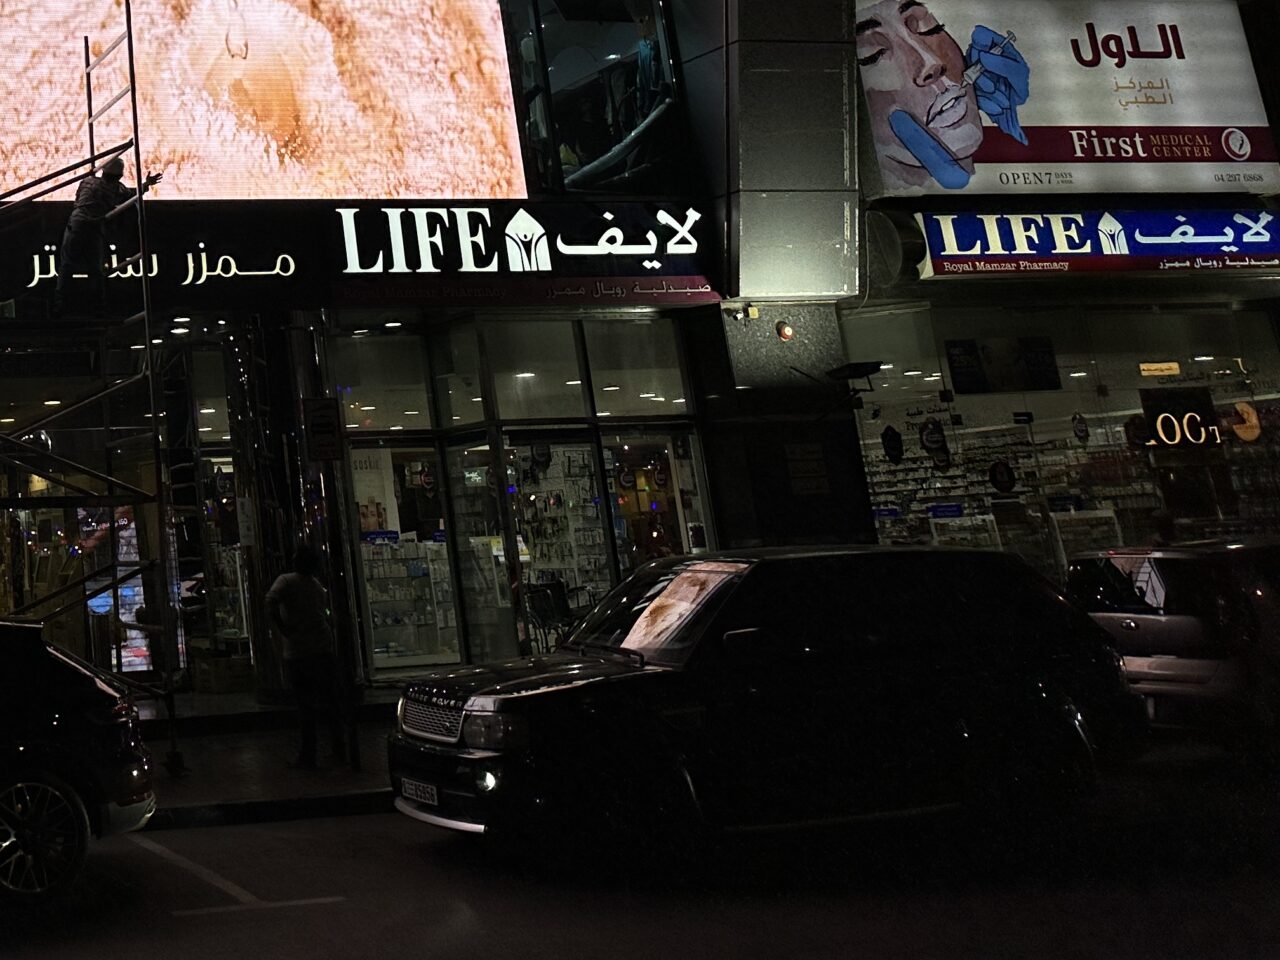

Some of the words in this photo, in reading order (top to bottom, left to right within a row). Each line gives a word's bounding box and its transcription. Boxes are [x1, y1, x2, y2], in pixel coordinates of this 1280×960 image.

[1113, 76, 1171, 93] المركز
[1119, 93, 1174, 111] الطبي
[1069, 130, 1148, 159] First
[1149, 134, 1212, 146] MEDICAL
[1152, 145, 1212, 157] CENTER
[335, 208, 499, 274] LIFE
[556, 207, 702, 270] لايف
[932, 213, 1091, 256] LIFE
[1134, 211, 1274, 253] لايف
[181, 242, 296, 286] ممزر
[943, 261, 974, 273] Royal
[975, 261, 1017, 271] Mamzar
[1019, 261, 1069, 271] Pharmacy
